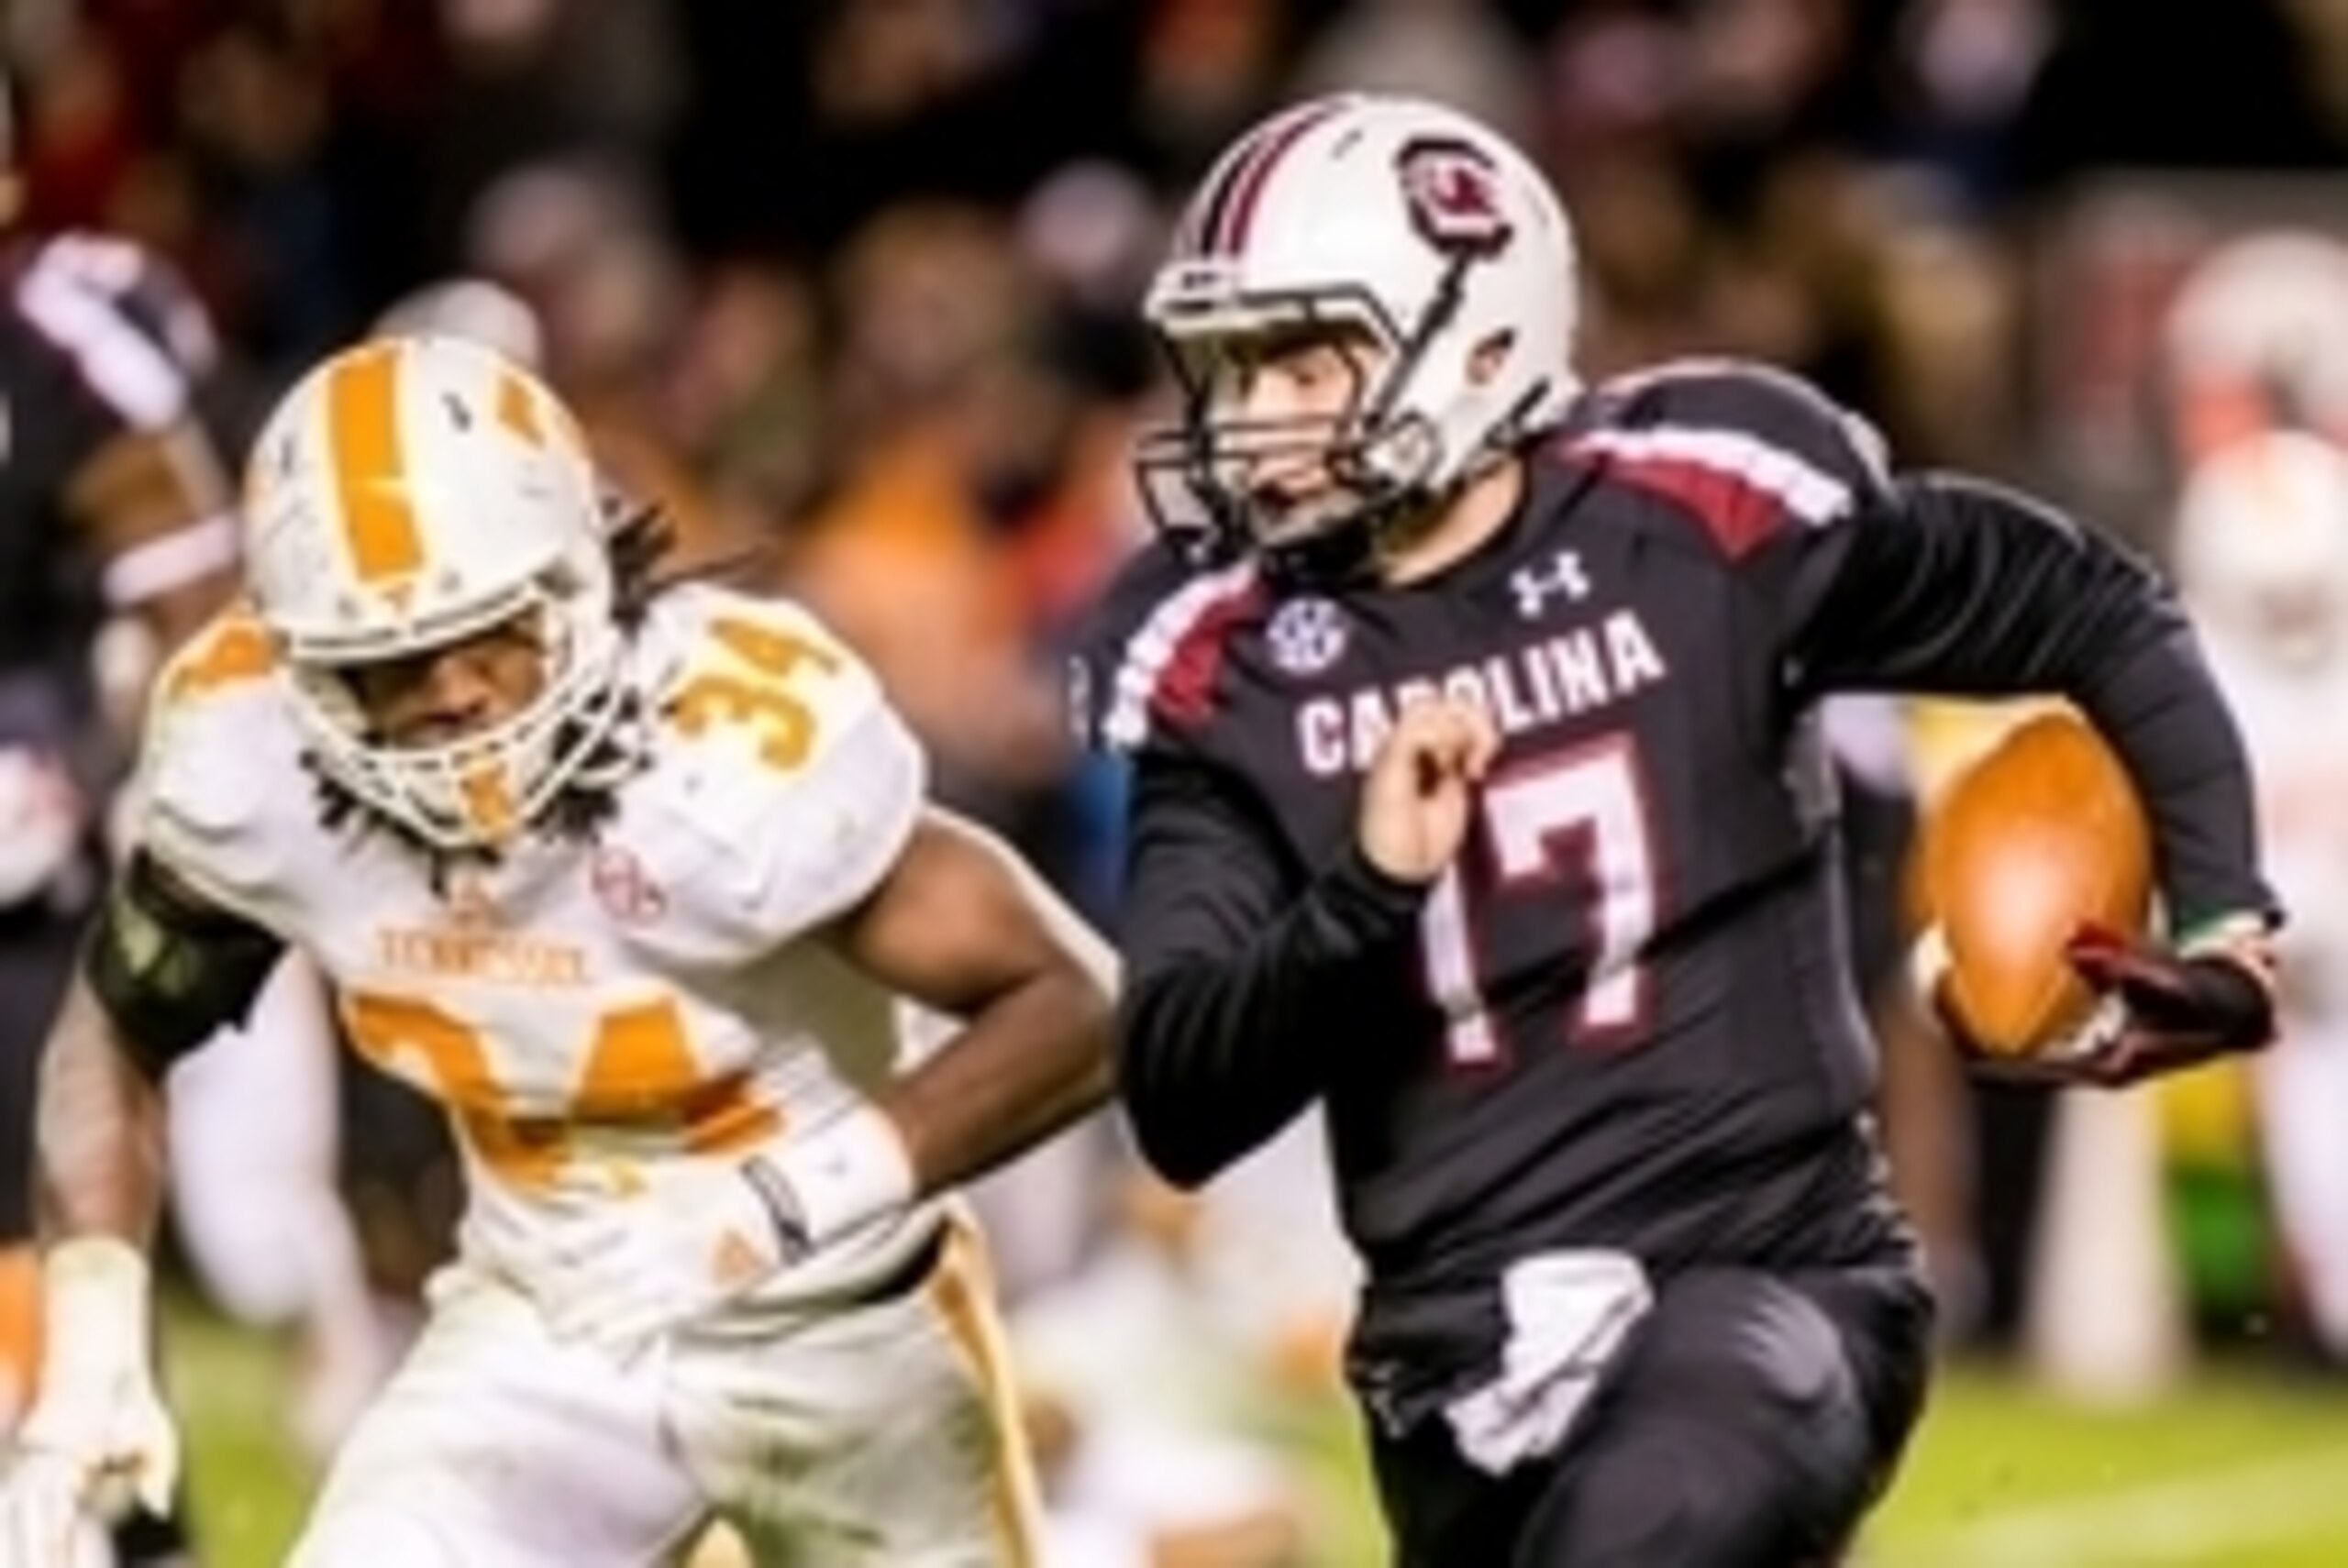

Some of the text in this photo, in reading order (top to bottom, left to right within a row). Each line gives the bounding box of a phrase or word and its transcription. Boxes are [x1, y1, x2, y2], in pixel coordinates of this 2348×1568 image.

[660, 616, 838, 770] 34
[1419, 732, 1663, 1071] 17
[343, 992, 784, 1198] 34
